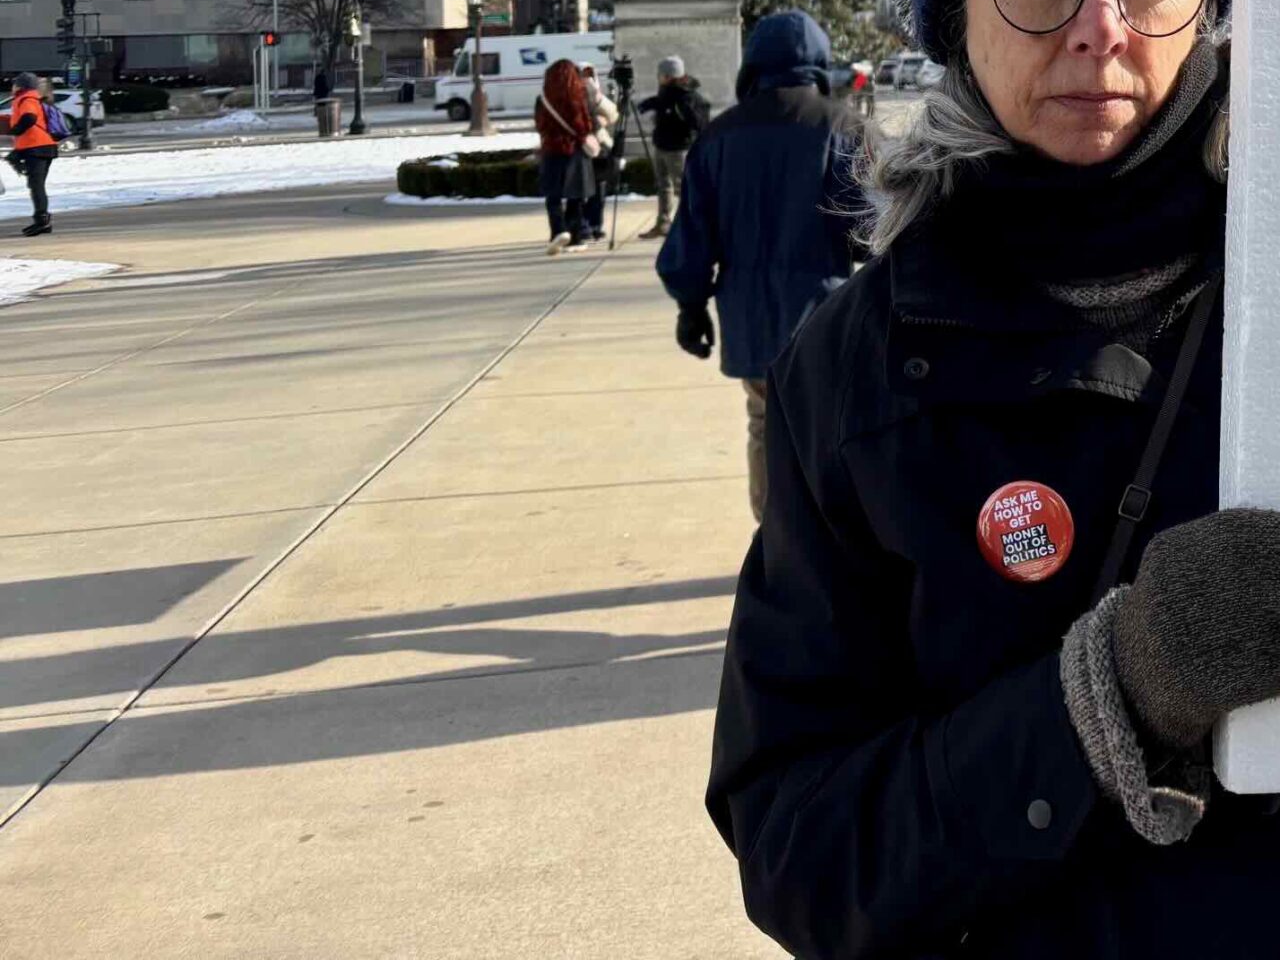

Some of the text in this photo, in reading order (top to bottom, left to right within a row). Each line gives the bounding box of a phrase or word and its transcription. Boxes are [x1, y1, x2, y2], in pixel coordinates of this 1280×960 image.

[994, 490, 1039, 511] ASK ME
[994, 501, 1042, 521] HOW TO
[1009, 514, 1032, 529] GET
[1002, 524, 1045, 544] MONEY
[1005, 535, 1047, 554] OUT OF
[1003, 544, 1056, 566] POLITICS
